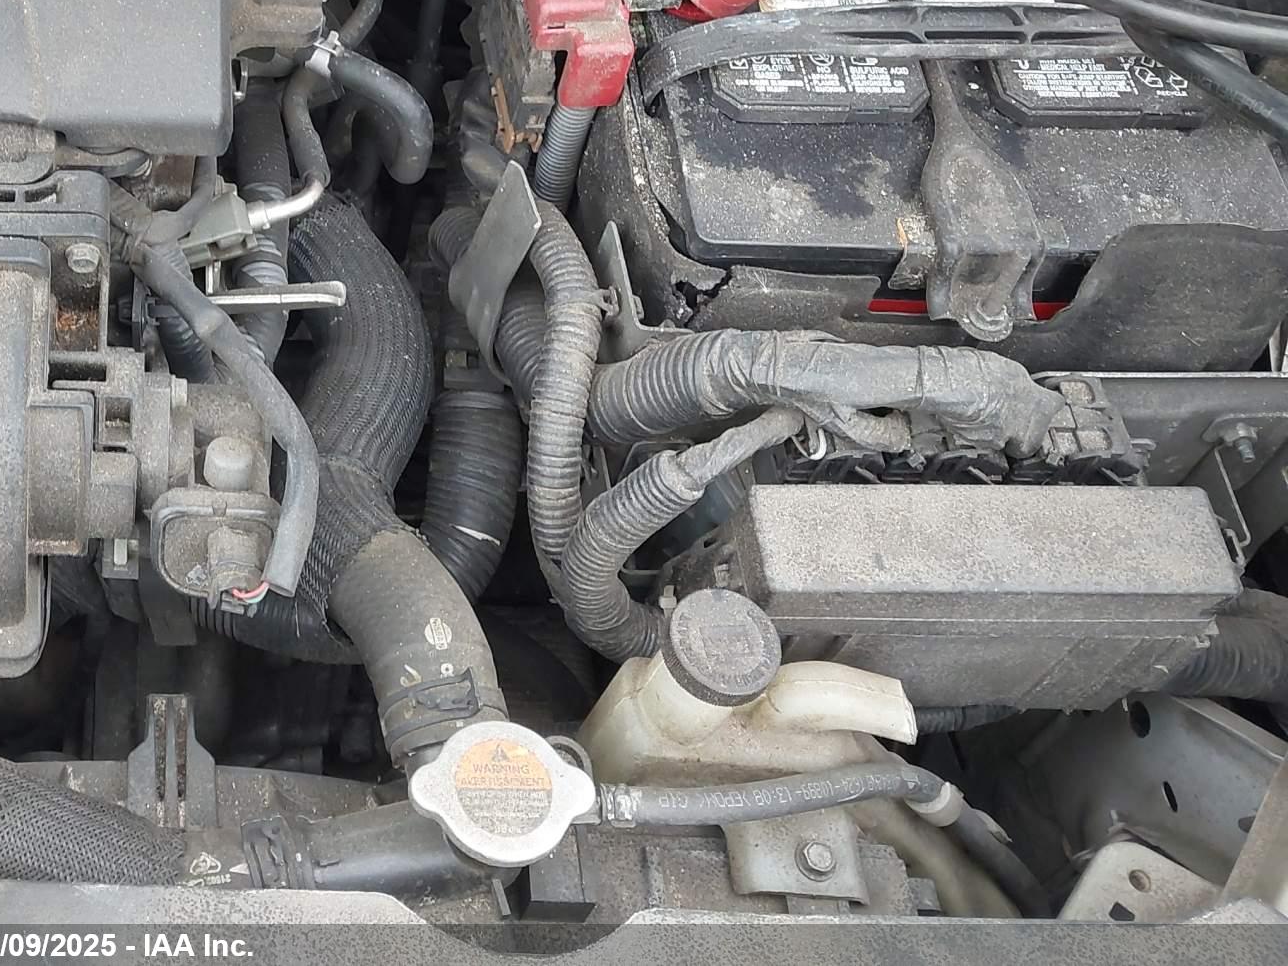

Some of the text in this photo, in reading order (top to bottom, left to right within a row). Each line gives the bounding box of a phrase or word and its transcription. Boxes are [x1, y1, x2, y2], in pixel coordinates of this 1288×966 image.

[849, 66, 909, 75] SULFURIC ACID
[473, 763, 530, 774] WARNING
